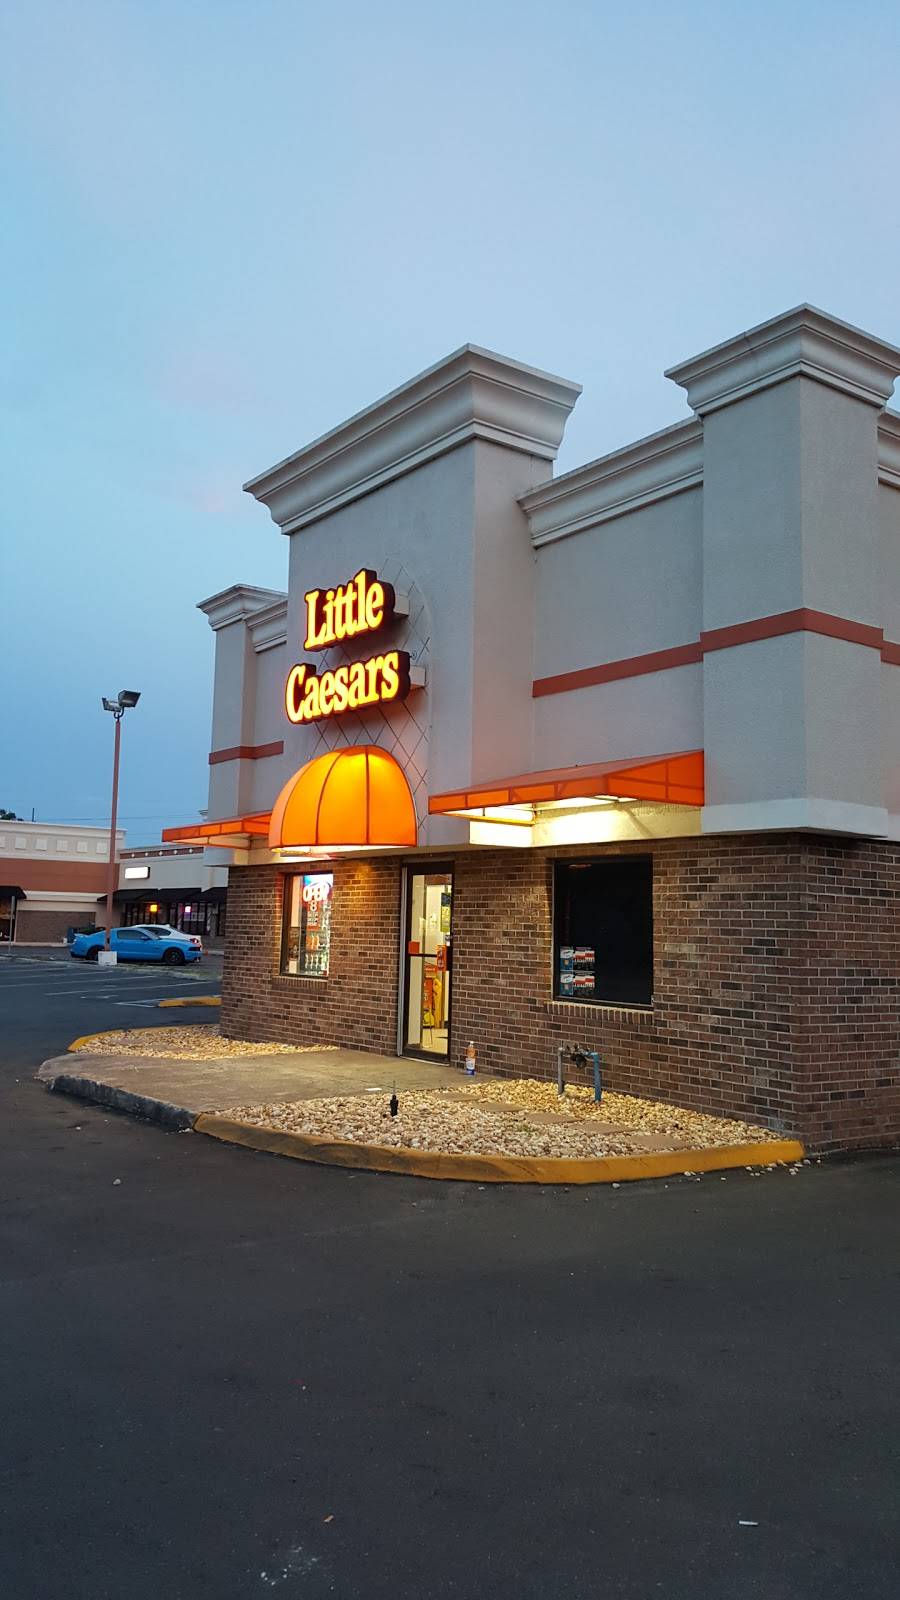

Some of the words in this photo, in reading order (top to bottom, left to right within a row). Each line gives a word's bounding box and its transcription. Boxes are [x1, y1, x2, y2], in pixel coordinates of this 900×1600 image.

[304, 570, 384, 649] Little
[286, 652, 399, 723] Caesars
[302, 883, 329, 902] OPEN
